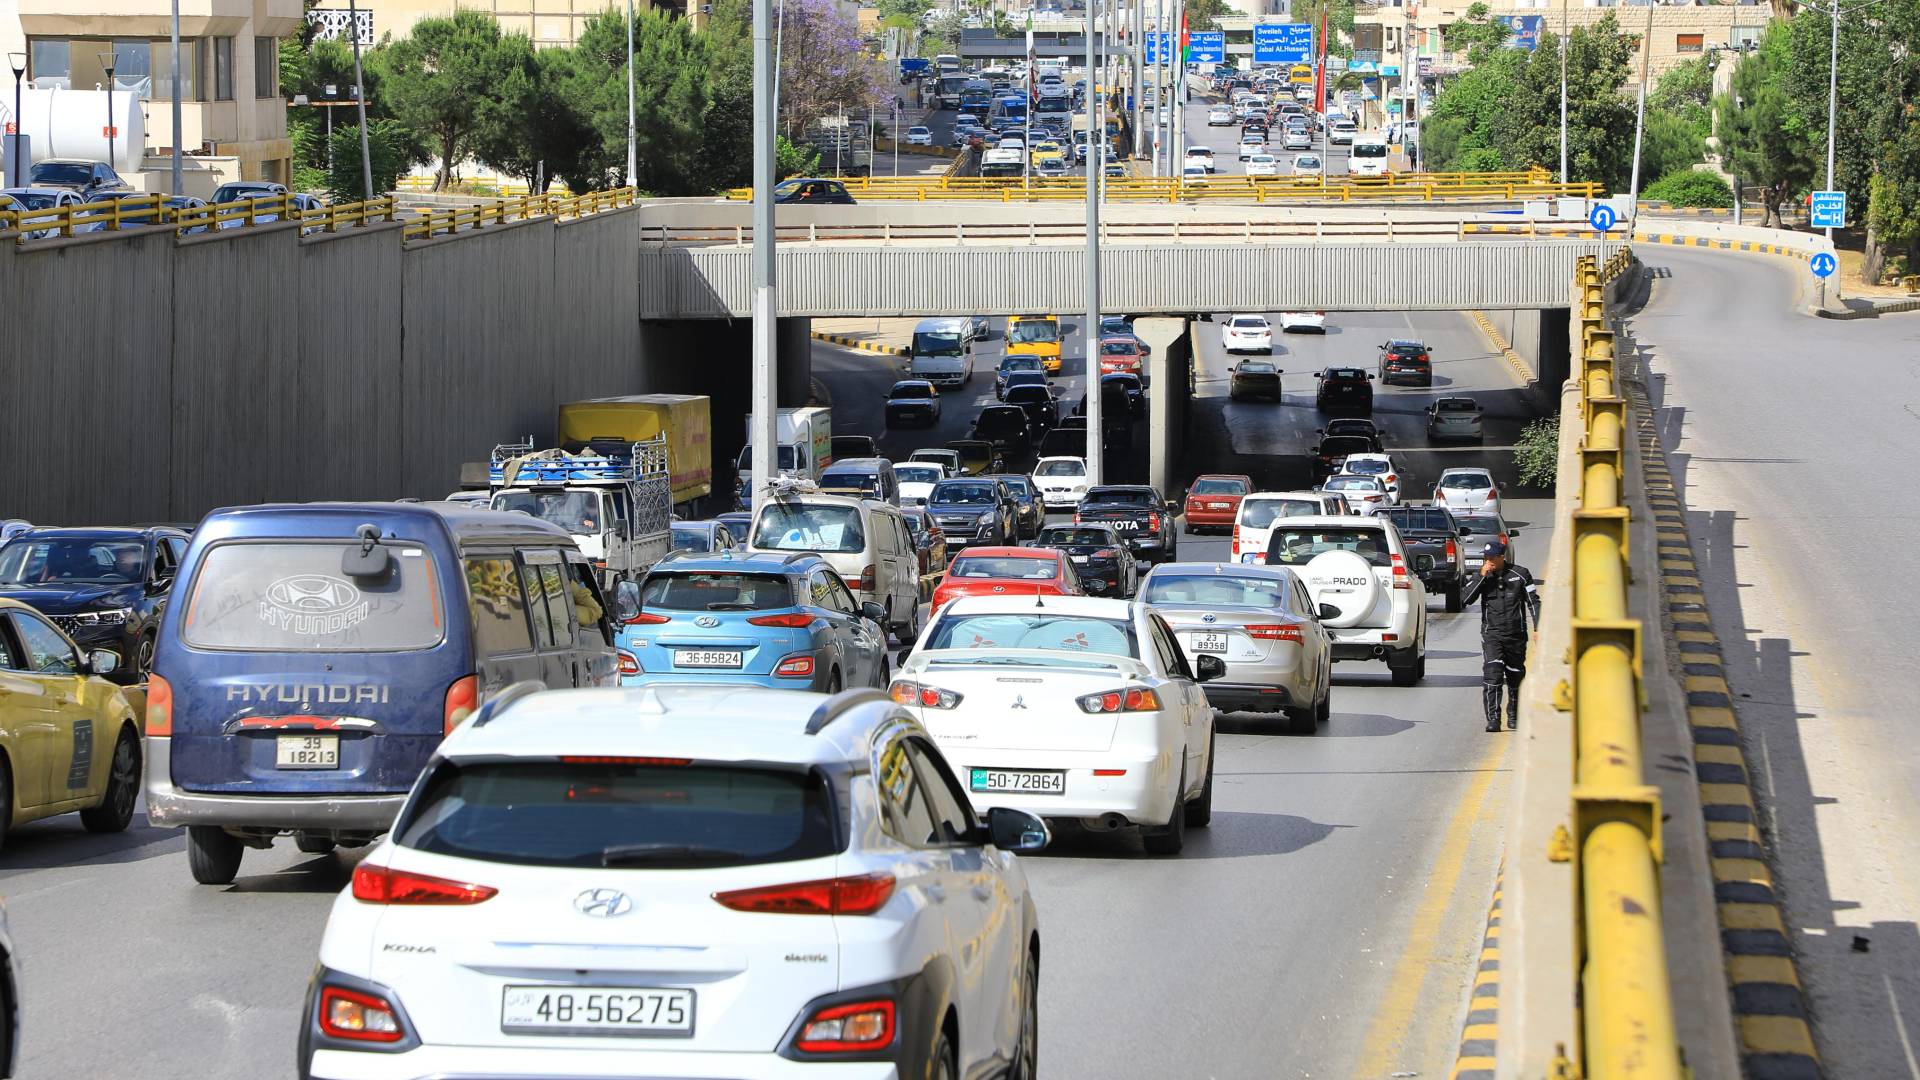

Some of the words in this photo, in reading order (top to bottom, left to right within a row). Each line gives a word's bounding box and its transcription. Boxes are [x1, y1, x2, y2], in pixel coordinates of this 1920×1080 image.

[1289, 26, 1311, 36] صويلح
[1255, 36, 1289, 46] الحسين
[1290, 36, 1310, 45] جبل
[1832, 213, 1841, 224] H
[1333, 577, 1367, 586] PRADO
[260, 601, 368, 634] HYUNDAI
[1206, 634, 1217, 642] 23
[1198, 642, 1225, 650] 89358
[686, 652, 740, 664] 36-85824
[227, 684, 389, 704] HYUNDAI
[303, 737, 322, 750] 39
[290, 751, 336, 763] 18213
[988, 773, 1061, 790] 50-72864
[784, 952, 828, 963] electric
[536, 994, 685, 1024] 48-56275
